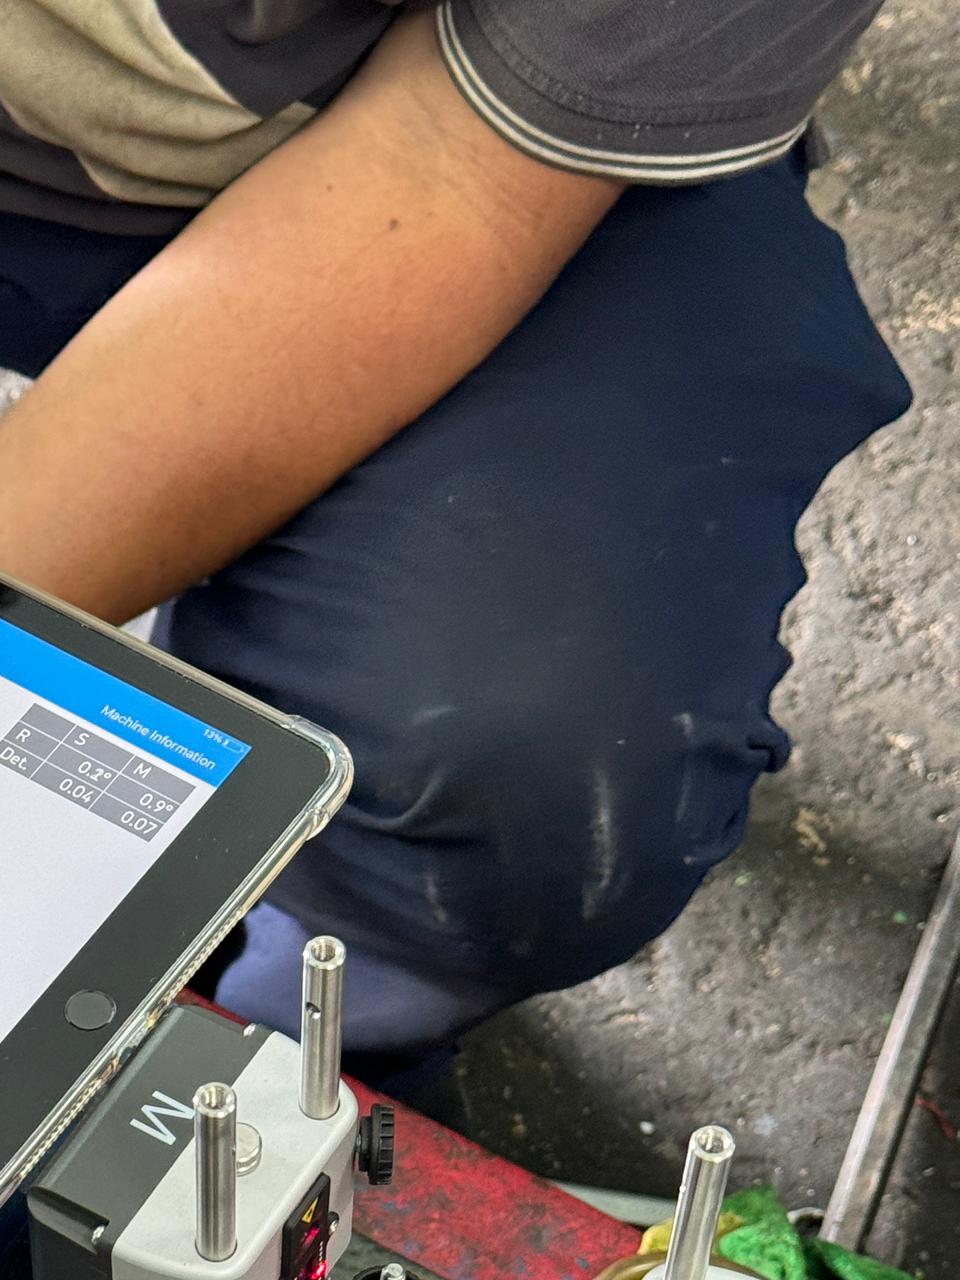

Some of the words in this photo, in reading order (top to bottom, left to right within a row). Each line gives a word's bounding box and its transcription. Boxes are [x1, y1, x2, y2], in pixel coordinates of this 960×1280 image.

[15, 728, 32, 743] R
[74, 733, 90, 746] S
[100, 704, 150, 736] Machine
[149, 730, 216, 770] Information
[202, 729, 223, 745] 13%
[0, 746, 27, 770] Det.
[133, 763, 151, 779] M
[59, 778, 95, 804] 0.04
[121, 811, 158, 835] 0.07
[129, 1090, 195, 1146] M
